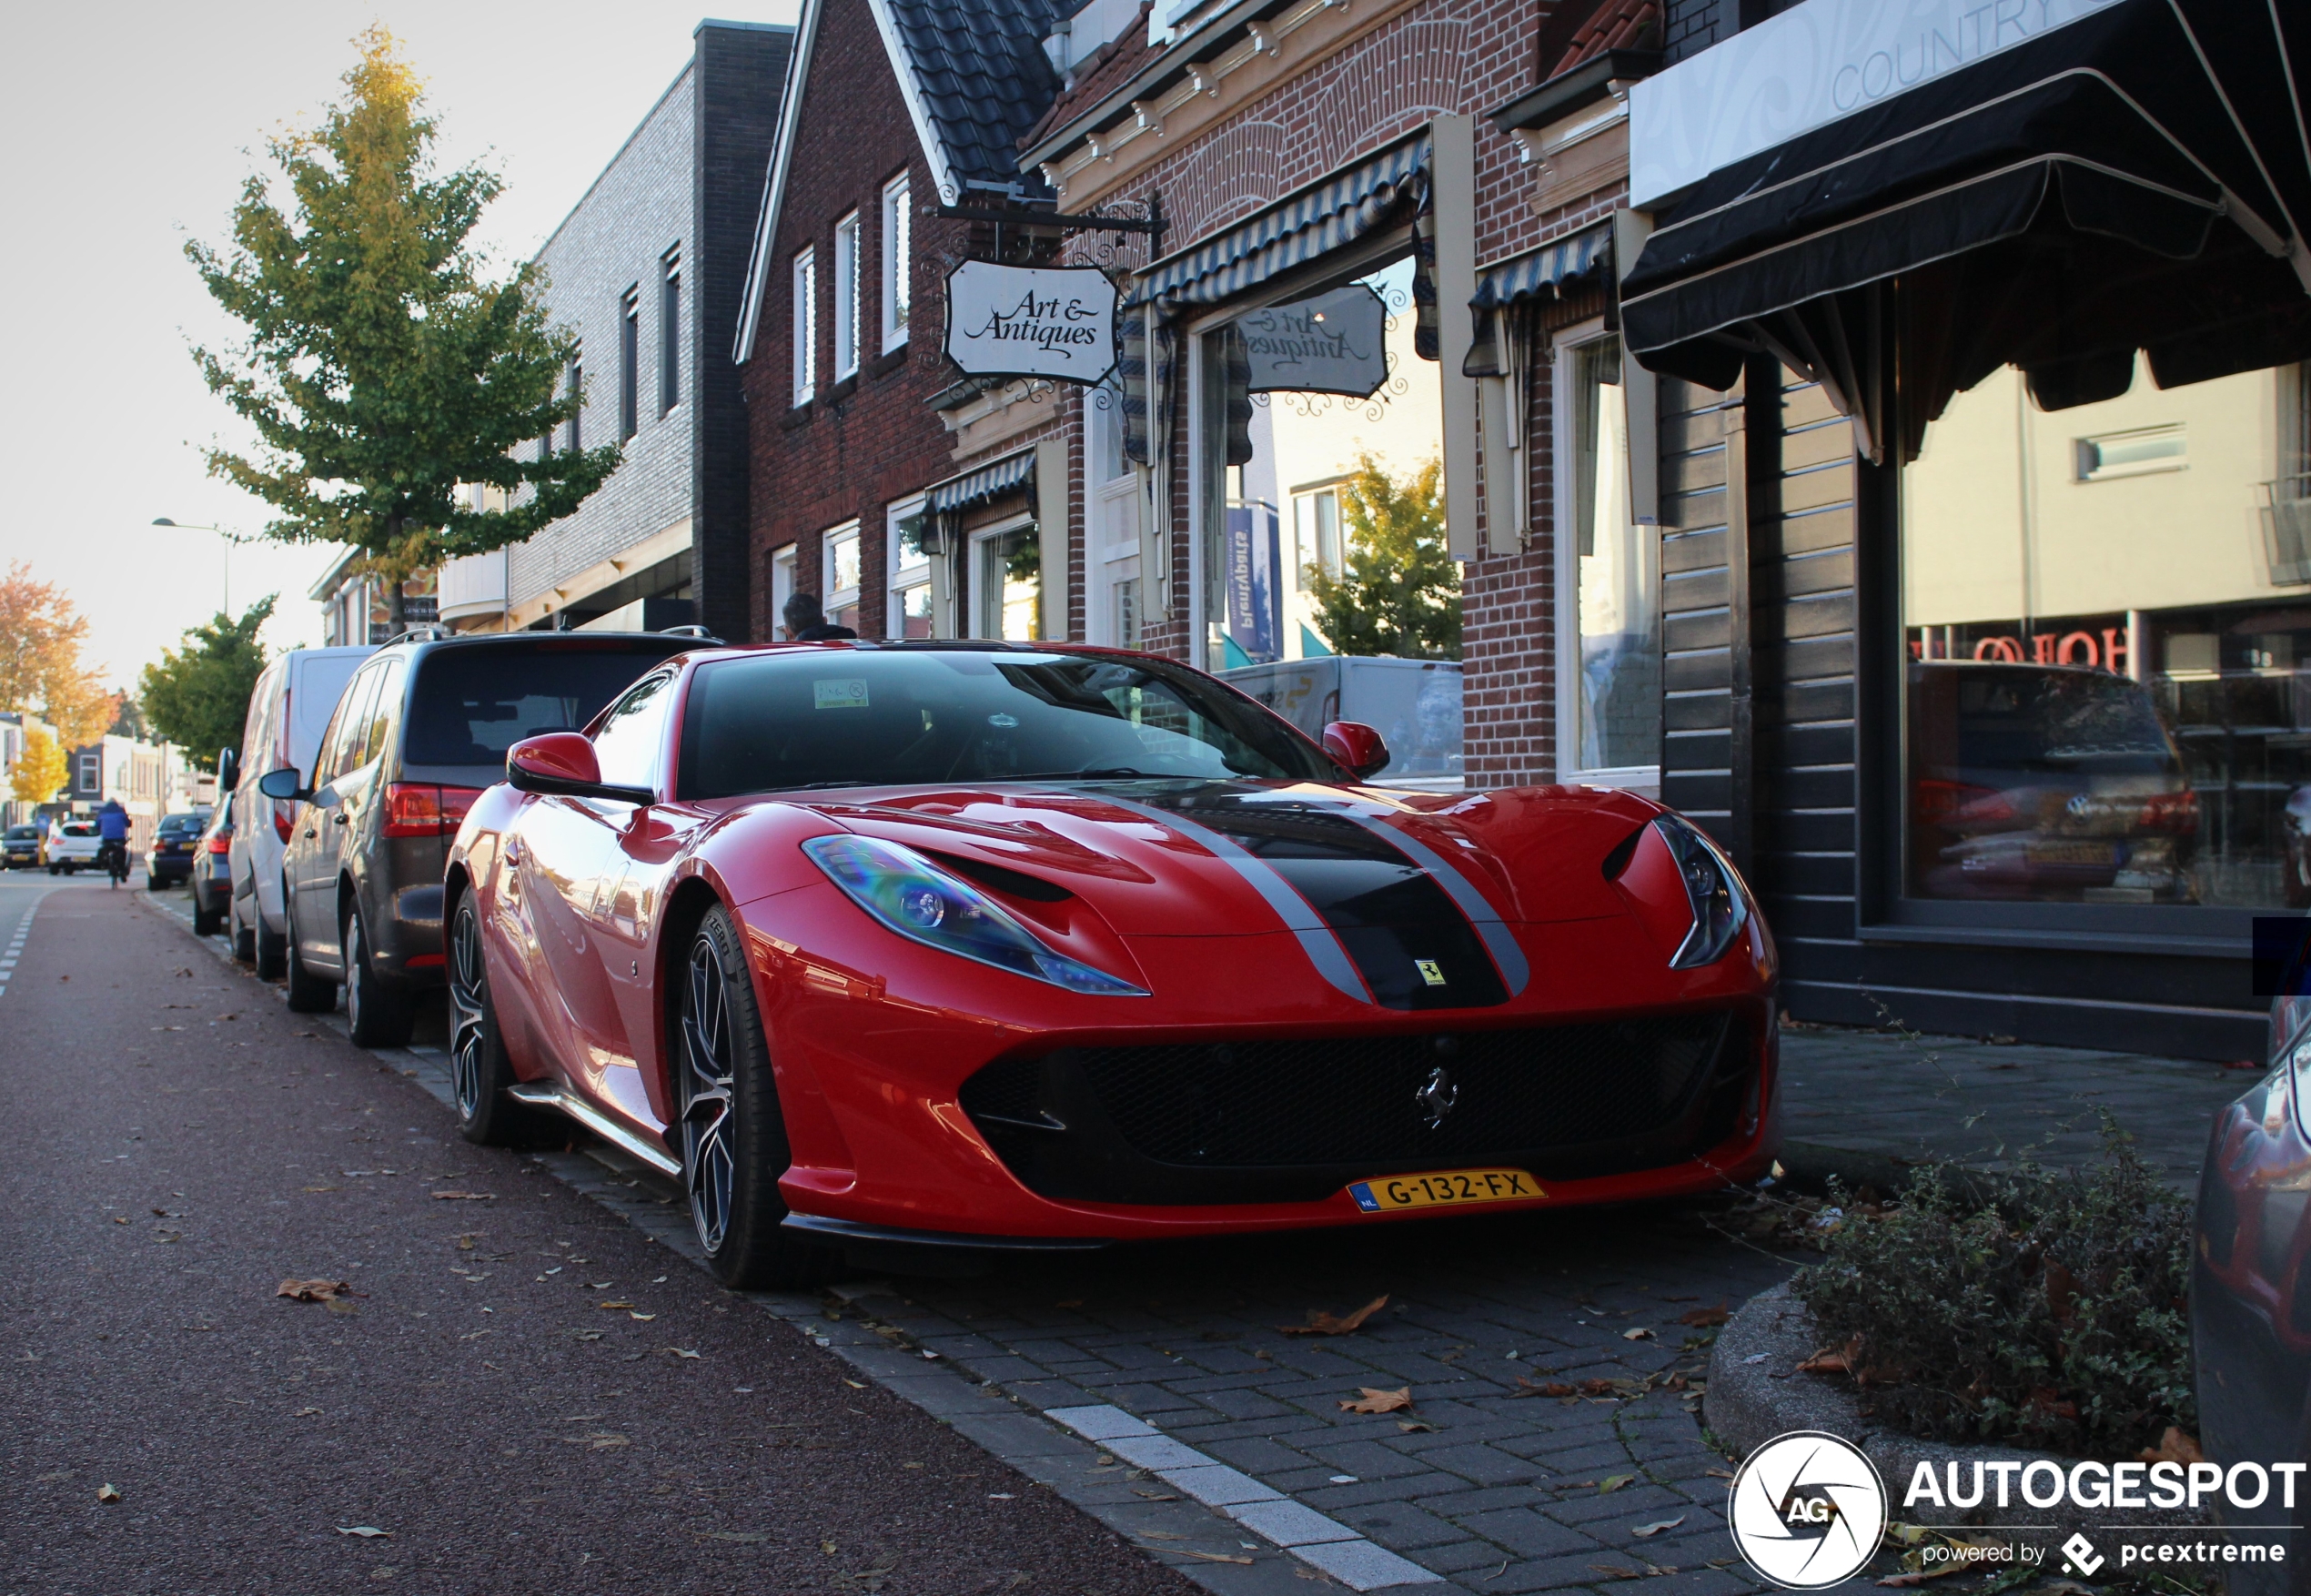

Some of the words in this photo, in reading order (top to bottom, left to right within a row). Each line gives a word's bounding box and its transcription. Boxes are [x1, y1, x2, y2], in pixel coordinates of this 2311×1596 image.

[1832, 0, 2051, 112] COUNTRY
[991, 289, 1060, 320] Art
[1065, 298, 1099, 321] &
[964, 310, 1097, 359] Antiques
[710, 917, 730, 957] ZERO
[1361, 1199, 1378, 1207] NL
[1388, 1174, 1529, 1204] G-132-FX
